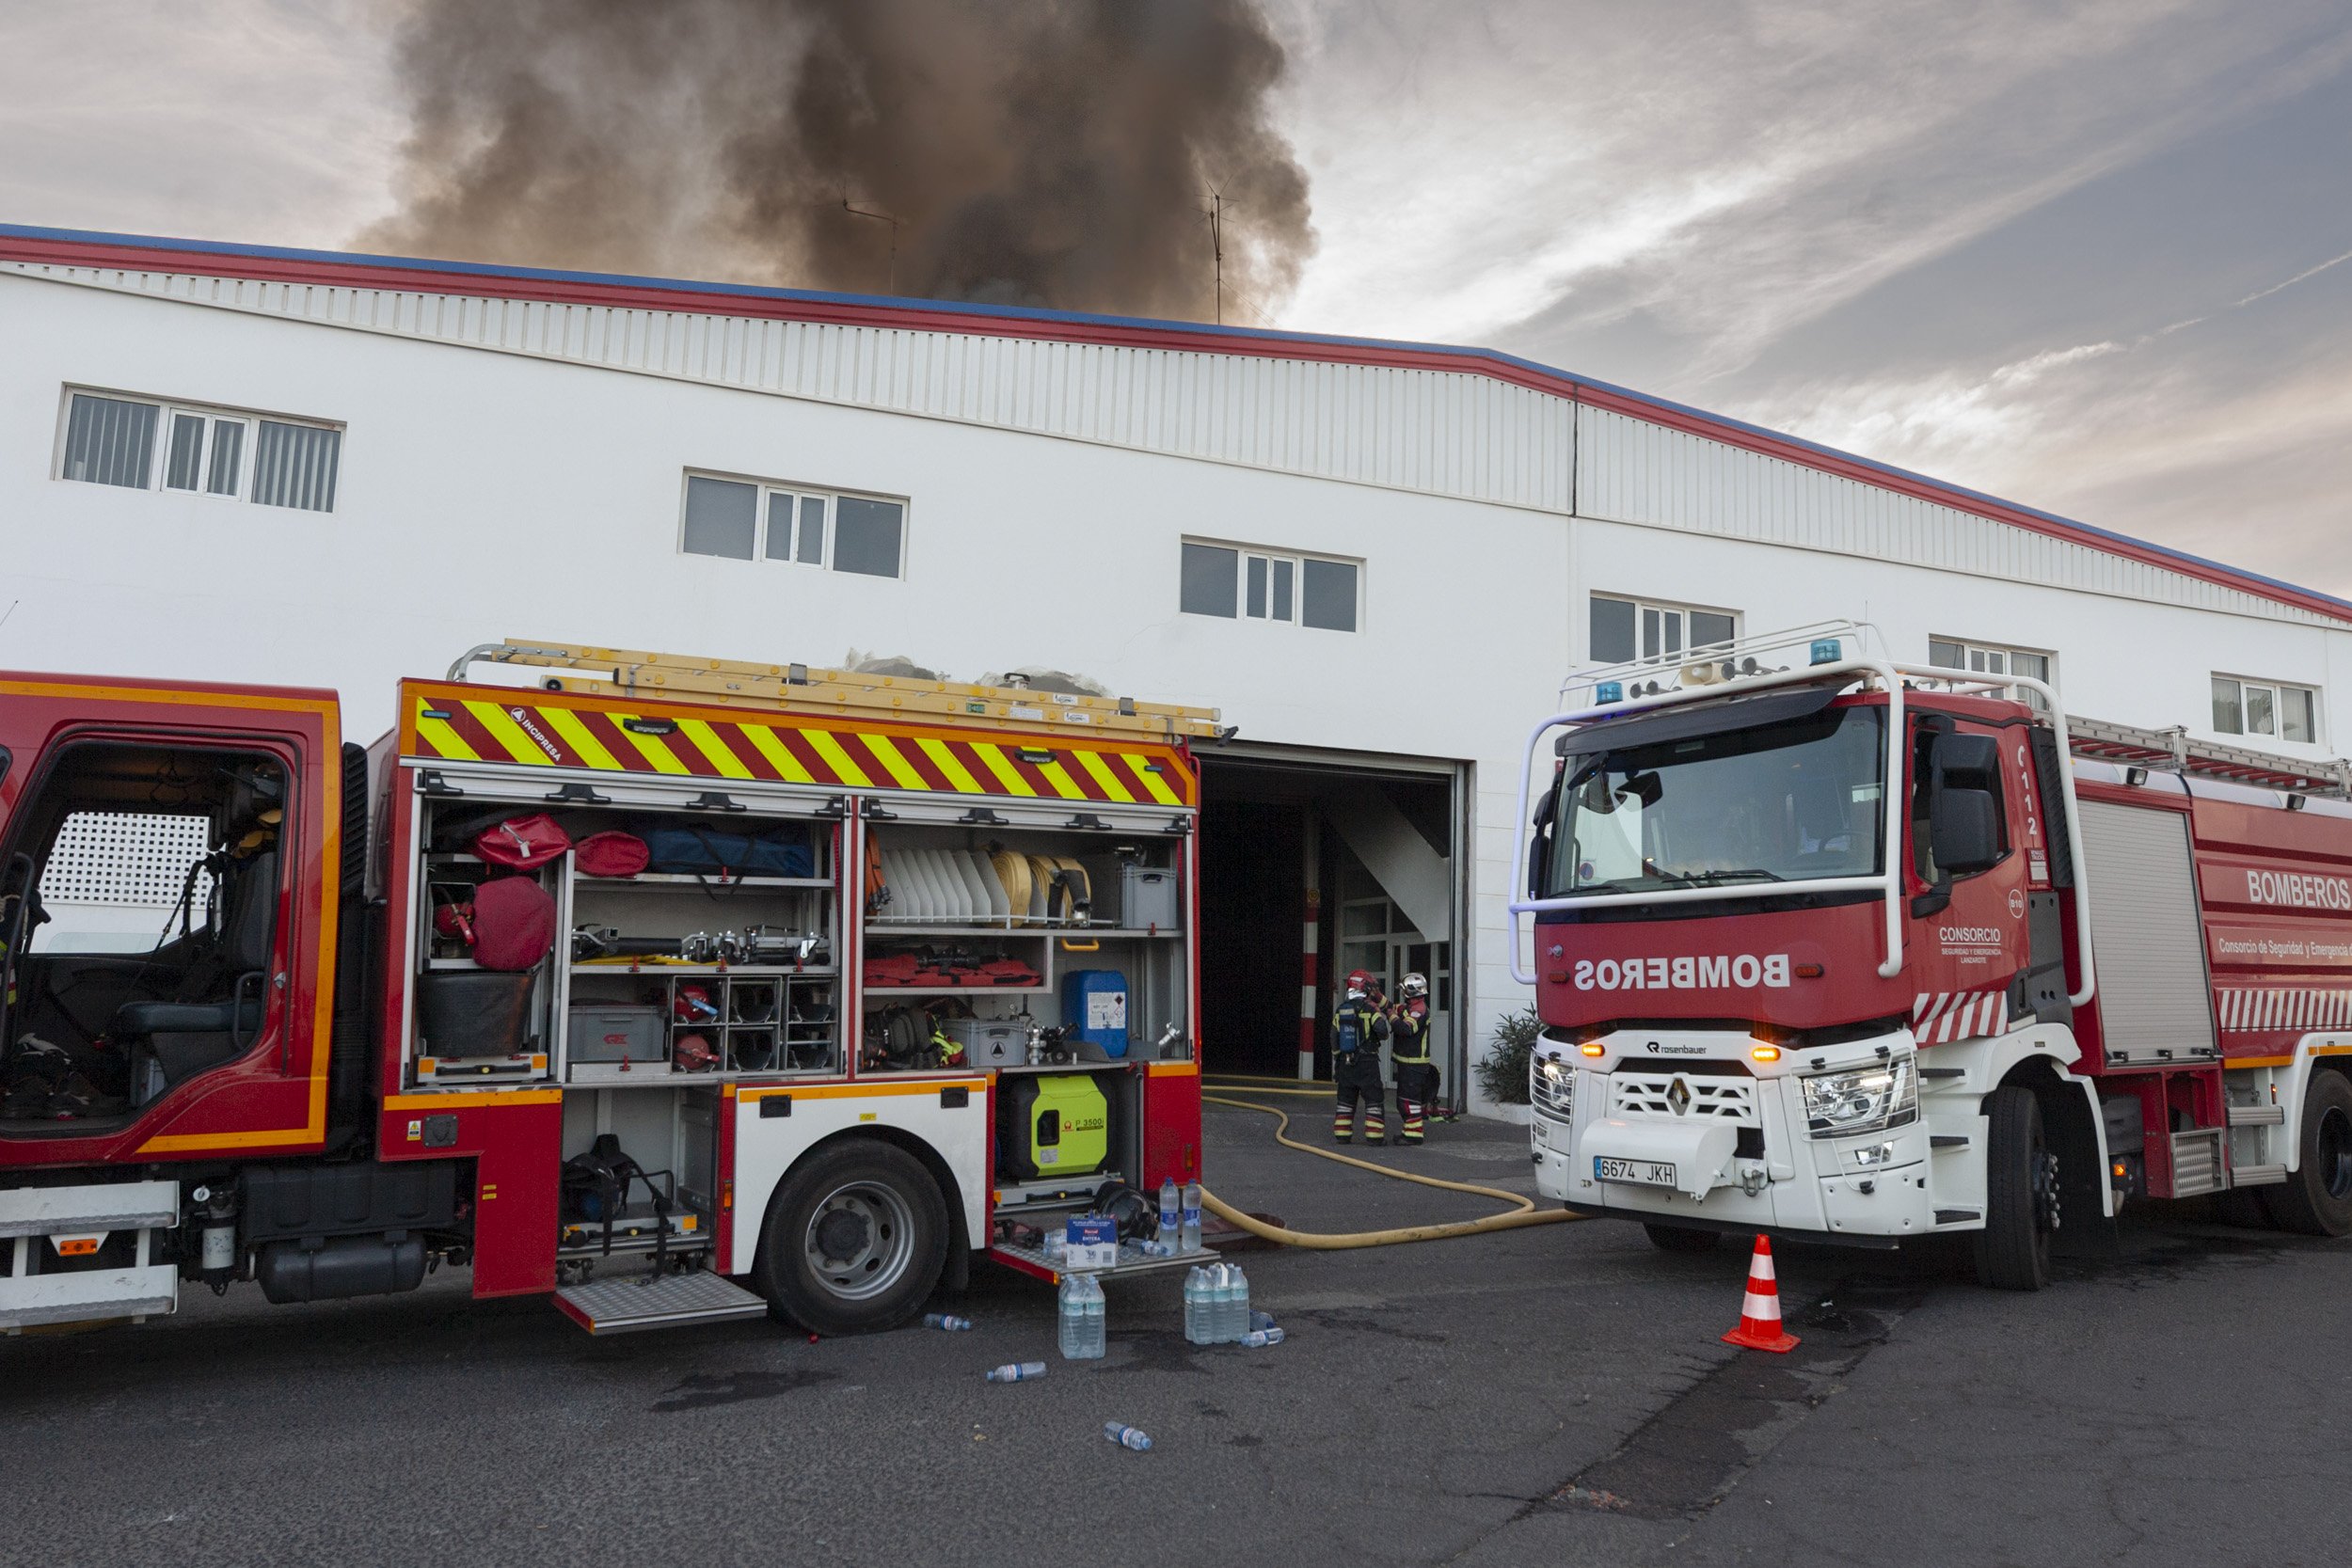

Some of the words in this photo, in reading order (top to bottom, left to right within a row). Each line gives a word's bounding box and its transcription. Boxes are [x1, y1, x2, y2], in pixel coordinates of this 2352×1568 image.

[522, 719, 561, 762] INCIPRESA
[2247, 870, 2351, 910] BOMBEROS
[1939, 927, 2001, 942] CONSORCIO
[1941, 947, 1969, 956] SEGURIDAD
[2218, 938, 2258, 954] Consorcio
[2258, 939, 2268, 955] de
[2268, 940, 2304, 958] Seguridad
[2304, 943, 2310, 959] y
[2310, 941, 2348, 959] Emergencia
[1661, 1044, 1708, 1054] rosenbauer
[1601, 1160, 1635, 1180] 6674
[1646, 1164, 1673, 1183] JKH
